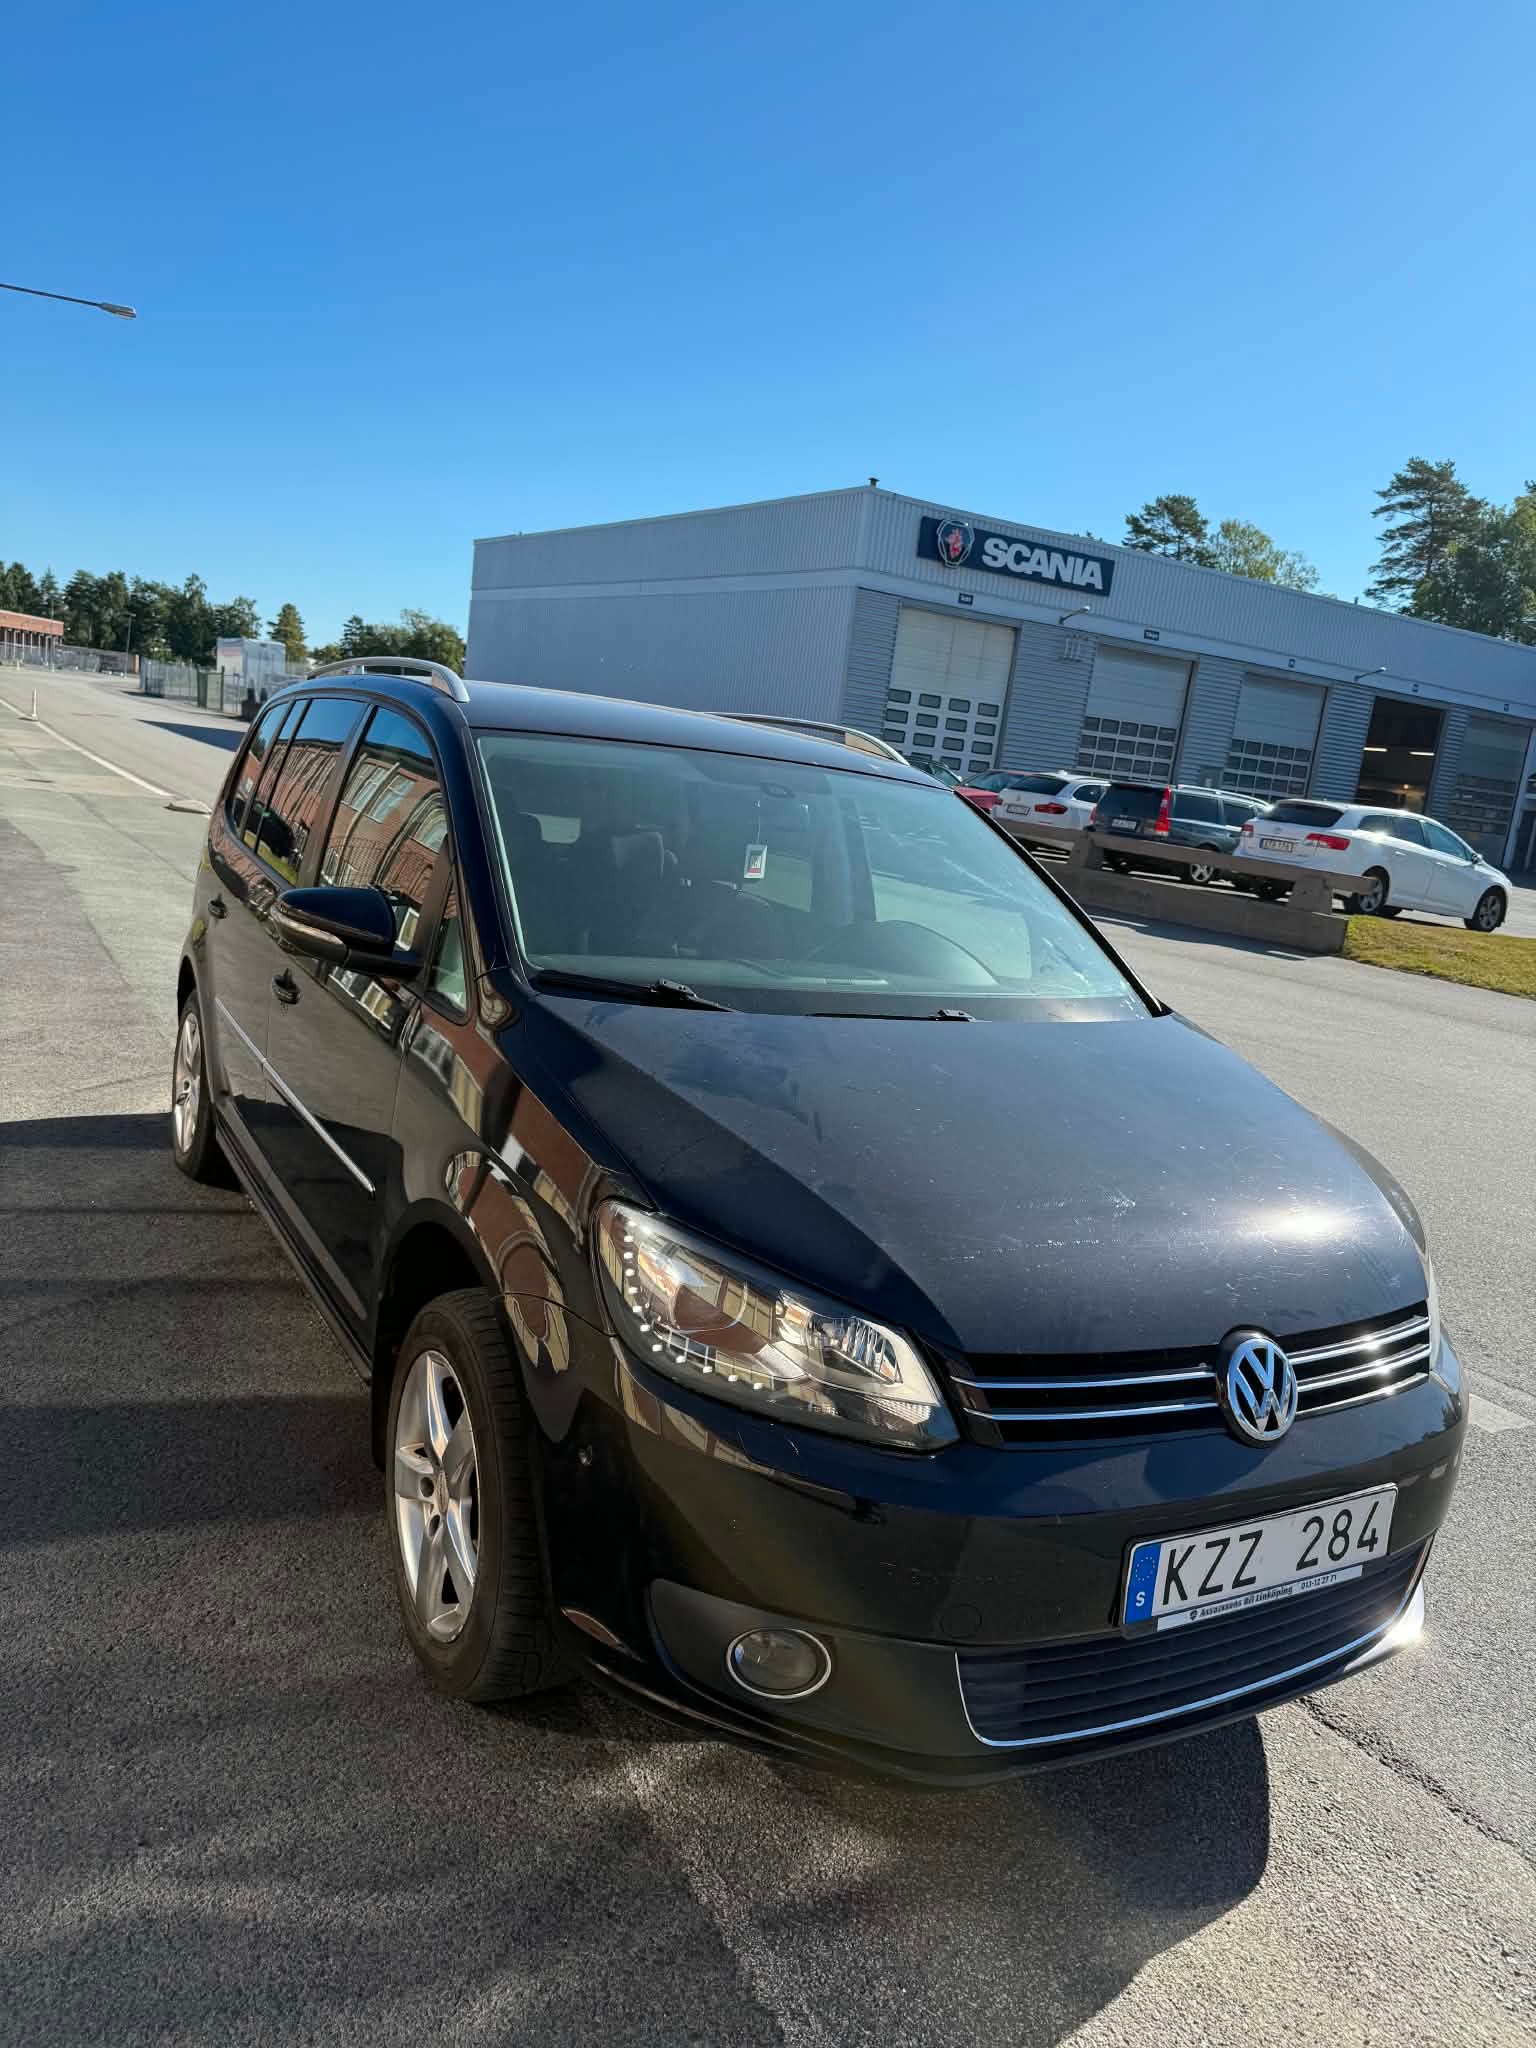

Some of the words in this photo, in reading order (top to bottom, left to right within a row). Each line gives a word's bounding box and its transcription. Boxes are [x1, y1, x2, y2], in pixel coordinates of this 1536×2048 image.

[982, 538, 1104, 590] SCANIA
[1162, 1529, 1263, 1606] KZZ
[1296, 1501, 1379, 1572] 284
[1135, 1591, 1145, 1607] S
